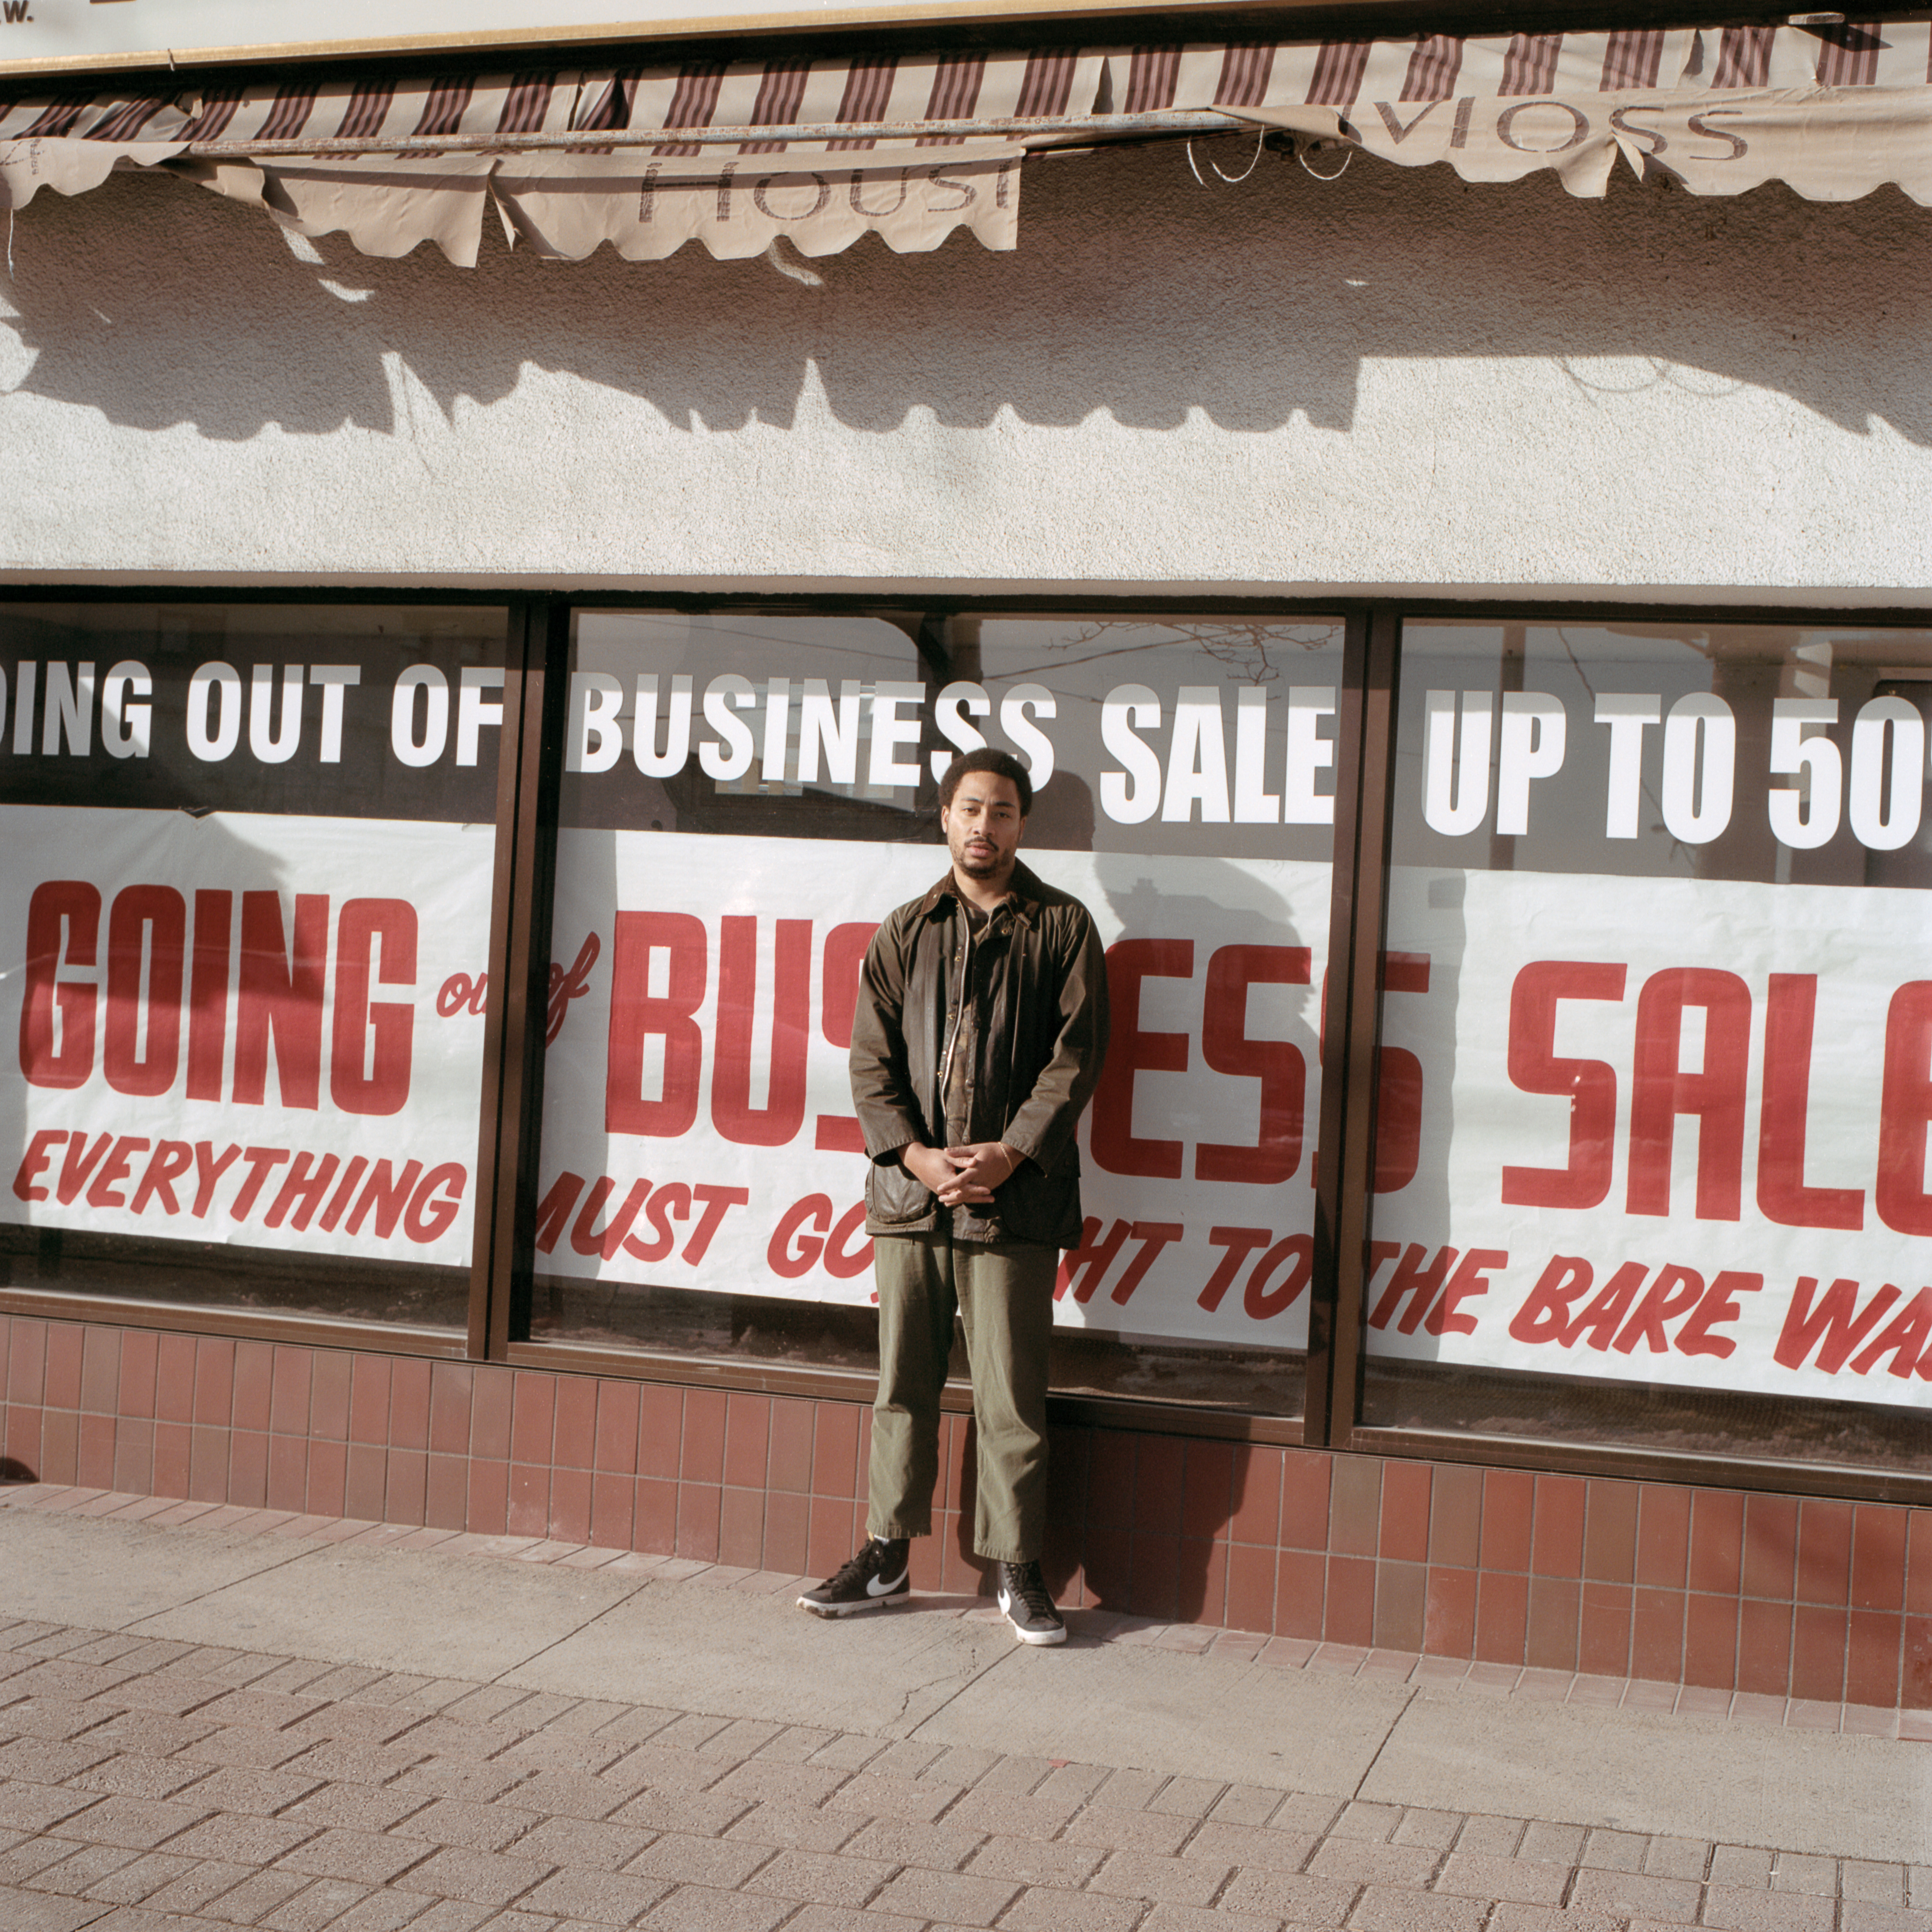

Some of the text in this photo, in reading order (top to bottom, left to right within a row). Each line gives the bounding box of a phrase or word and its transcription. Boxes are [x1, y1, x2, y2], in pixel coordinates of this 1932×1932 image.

[1342, 96, 1748, 160] VIOSS
[0, 660, 1932, 850] ING OUT OF BUSINESS SALE UP TO 50
[19, 880, 418, 1116] GOING
[436, 972, 488, 1017] ou
[12, 1130, 467, 1243] EVERYTHING
[1197, 1226, 1314, 1320] TO
[1509, 1254, 1764, 1359] BARE
[1773, 1276, 1932, 1382] WA
